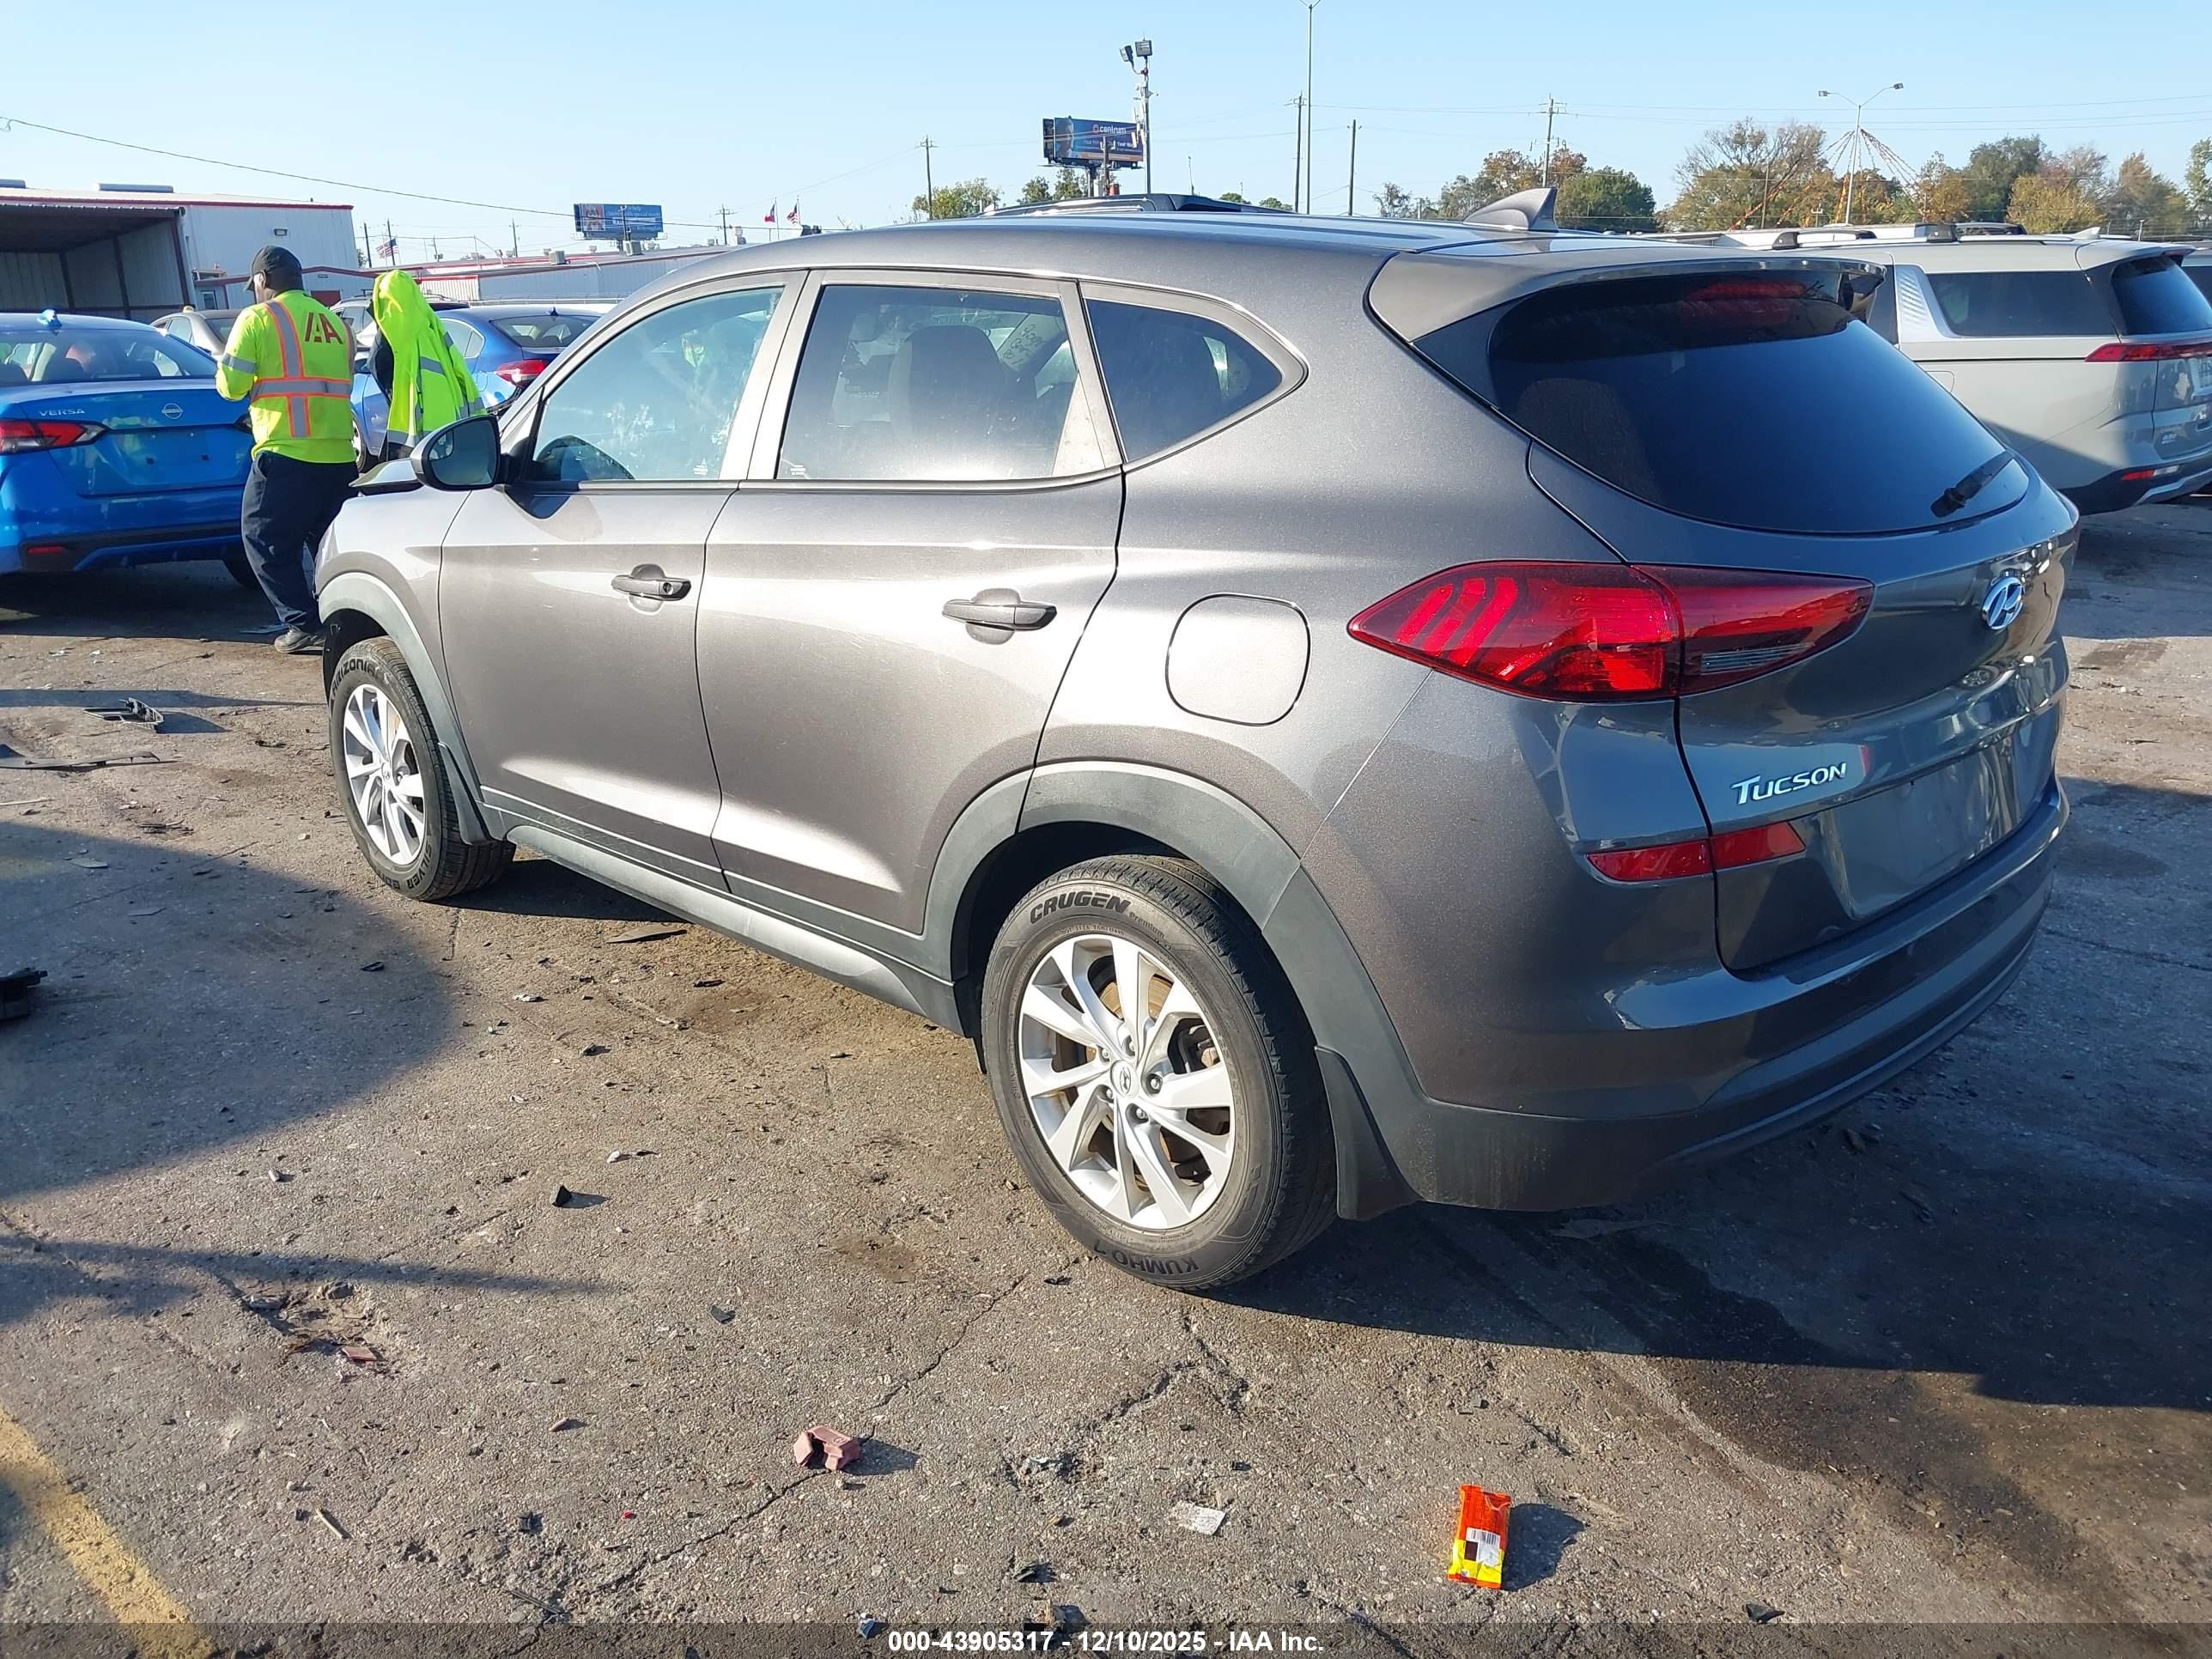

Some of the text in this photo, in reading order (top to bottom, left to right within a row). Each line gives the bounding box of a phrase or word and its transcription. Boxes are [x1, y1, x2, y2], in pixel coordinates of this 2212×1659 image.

[304, 312, 344, 344] IAA
[39, 408, 86, 416] VERSA
[1730, 763, 1847, 805] TUCSON
[1030, 890, 1132, 924] CRUGEN
[1112, 1250, 1200, 1275] KUMHO
